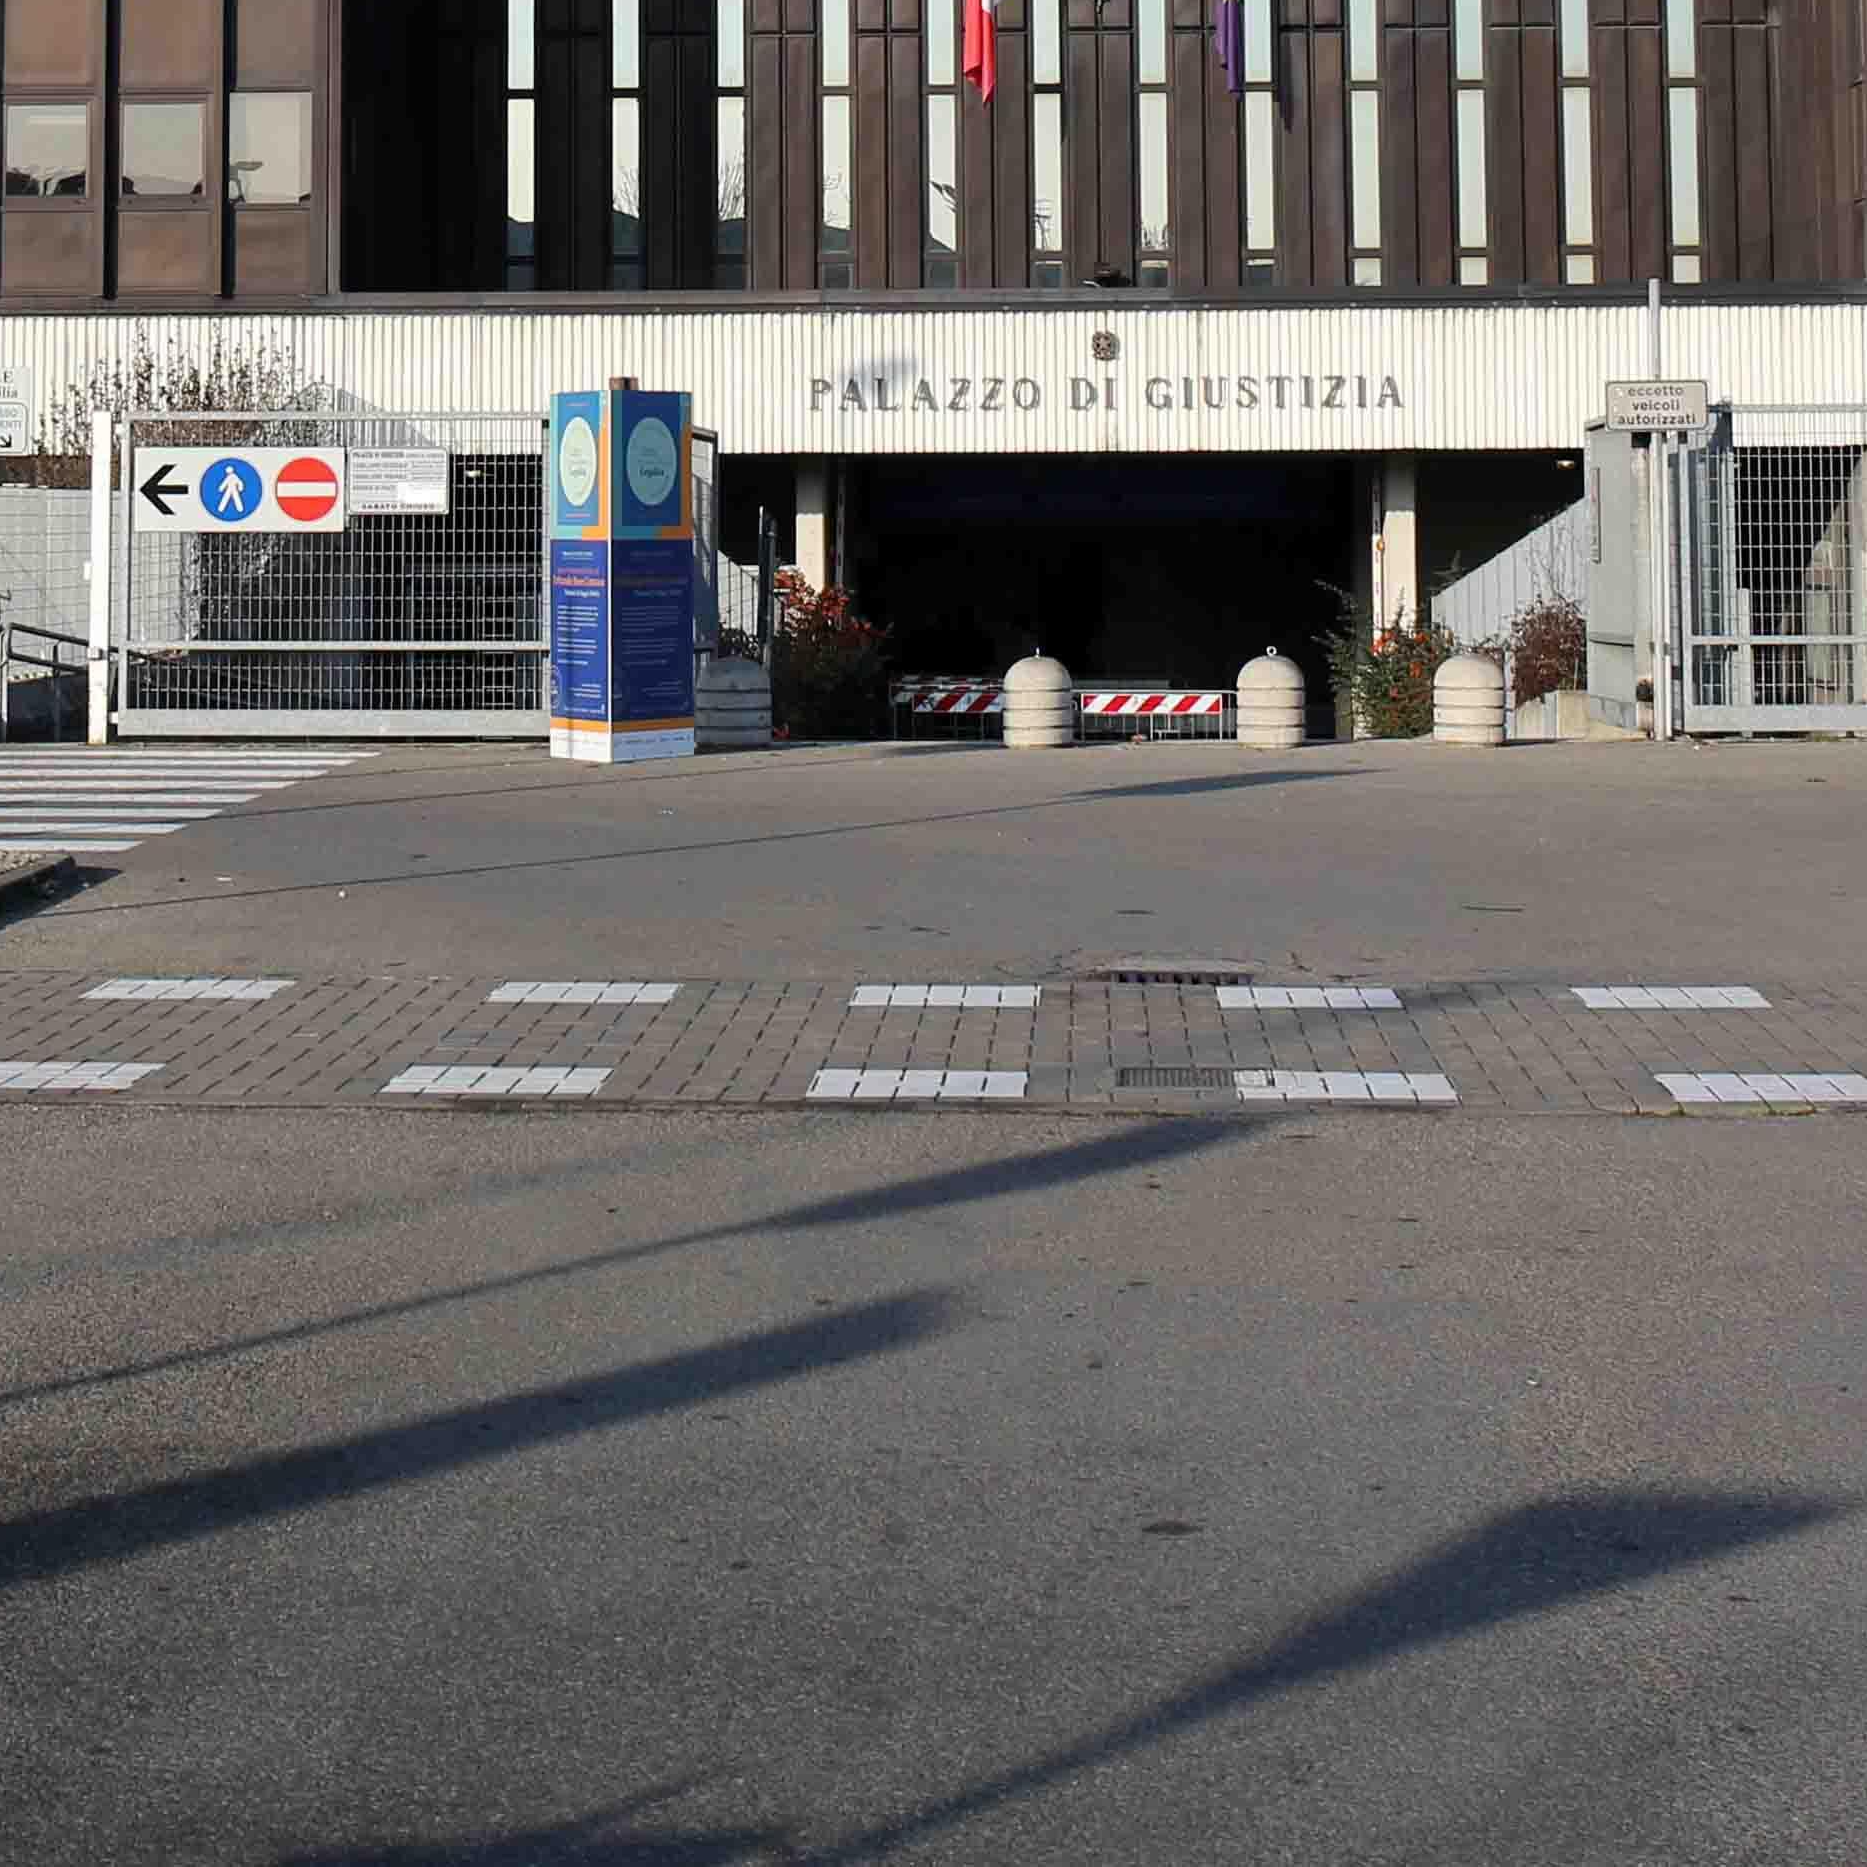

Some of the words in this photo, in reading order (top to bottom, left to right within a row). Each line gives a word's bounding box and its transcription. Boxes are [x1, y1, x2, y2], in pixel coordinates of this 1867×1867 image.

[809, 377, 1040, 412] PALAZZO
[1068, 377, 1118, 412] DI
[1145, 375, 1405, 411] GIUSTIZIA
[1628, 385, 1684, 396] eccetto
[1632, 399, 1680, 411] veicoli
[1618, 414, 1696, 425] autorizzati
